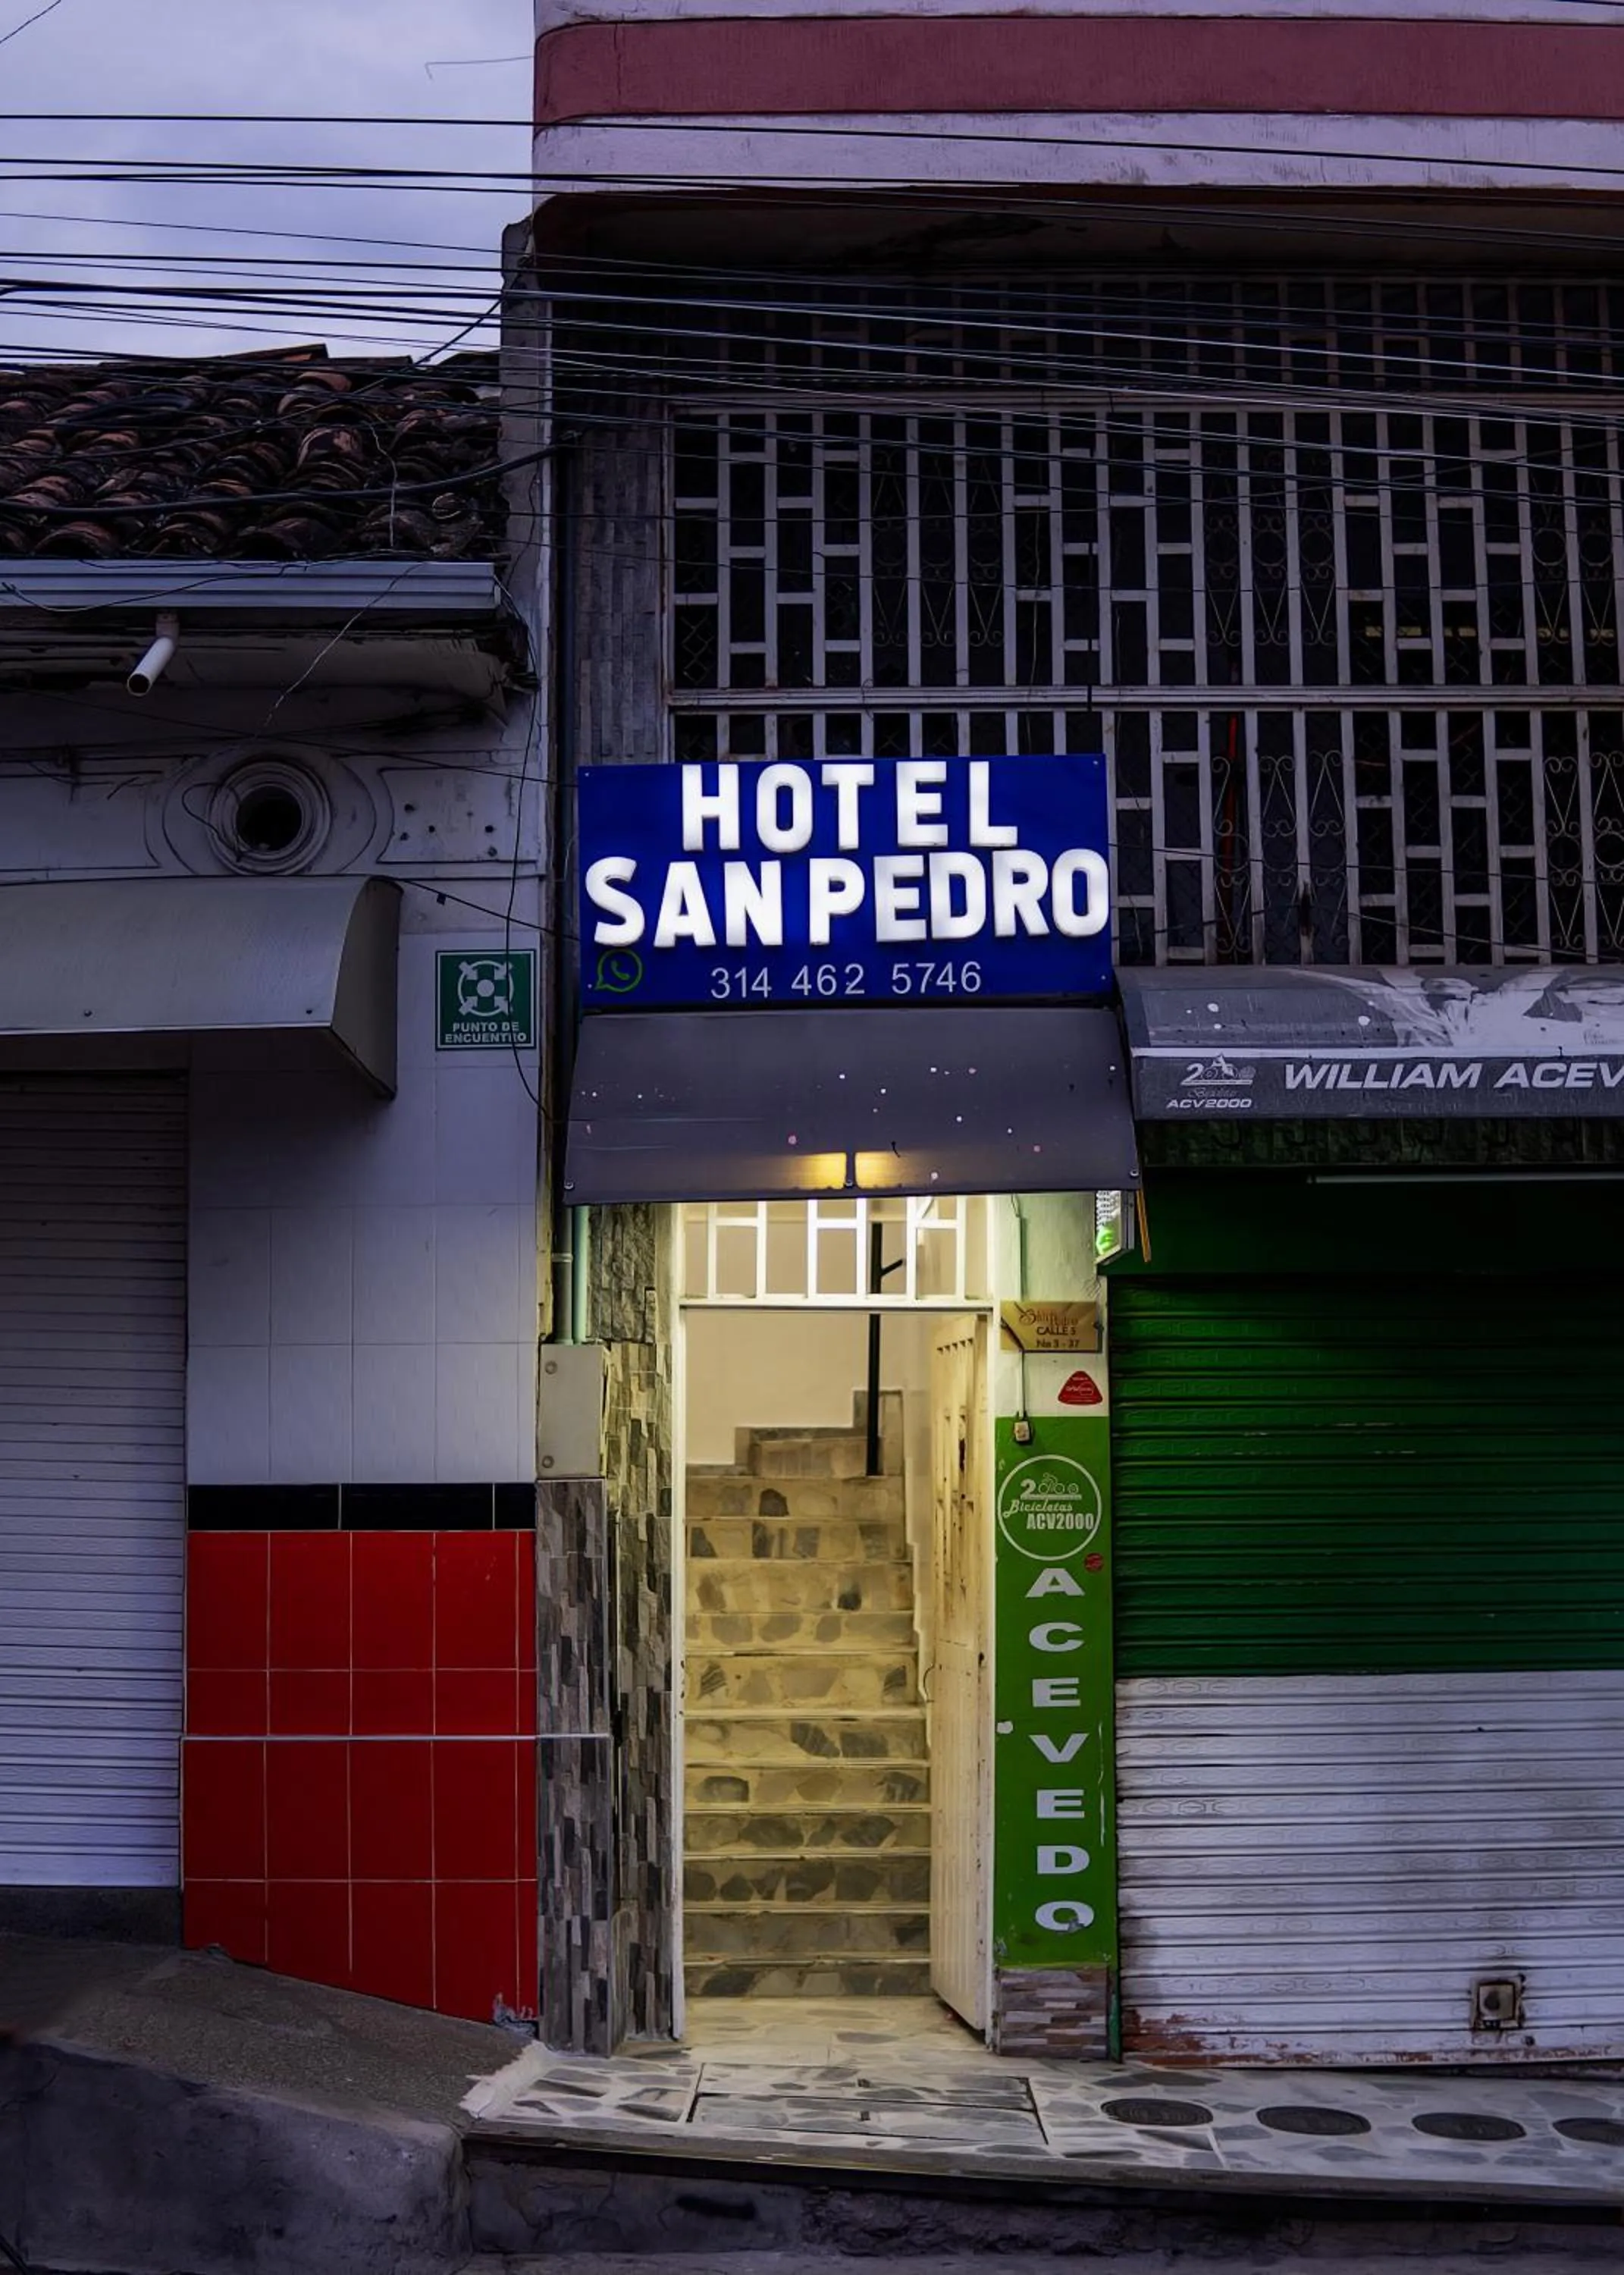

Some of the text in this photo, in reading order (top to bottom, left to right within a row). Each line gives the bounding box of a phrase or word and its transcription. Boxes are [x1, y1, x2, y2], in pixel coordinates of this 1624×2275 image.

[682, 761, 1018, 852] HOTEL
[585, 849, 1109, 947] SAN PEDRO
[710, 961, 983, 999] 314 462 5746
[453, 1021, 519, 1032] PUNTO DE
[1284, 1062, 1482, 1089] WILLIAM
[1166, 1098, 1252, 1109] ACV2000
[1036, 1326, 1069, 1335] CALLE
[1003, 1499, 1073, 1518] Bicicletas
[1027, 1514, 1094, 1530] ACV2000
[1025, 1567, 1094, 1931] ACEVEDO
